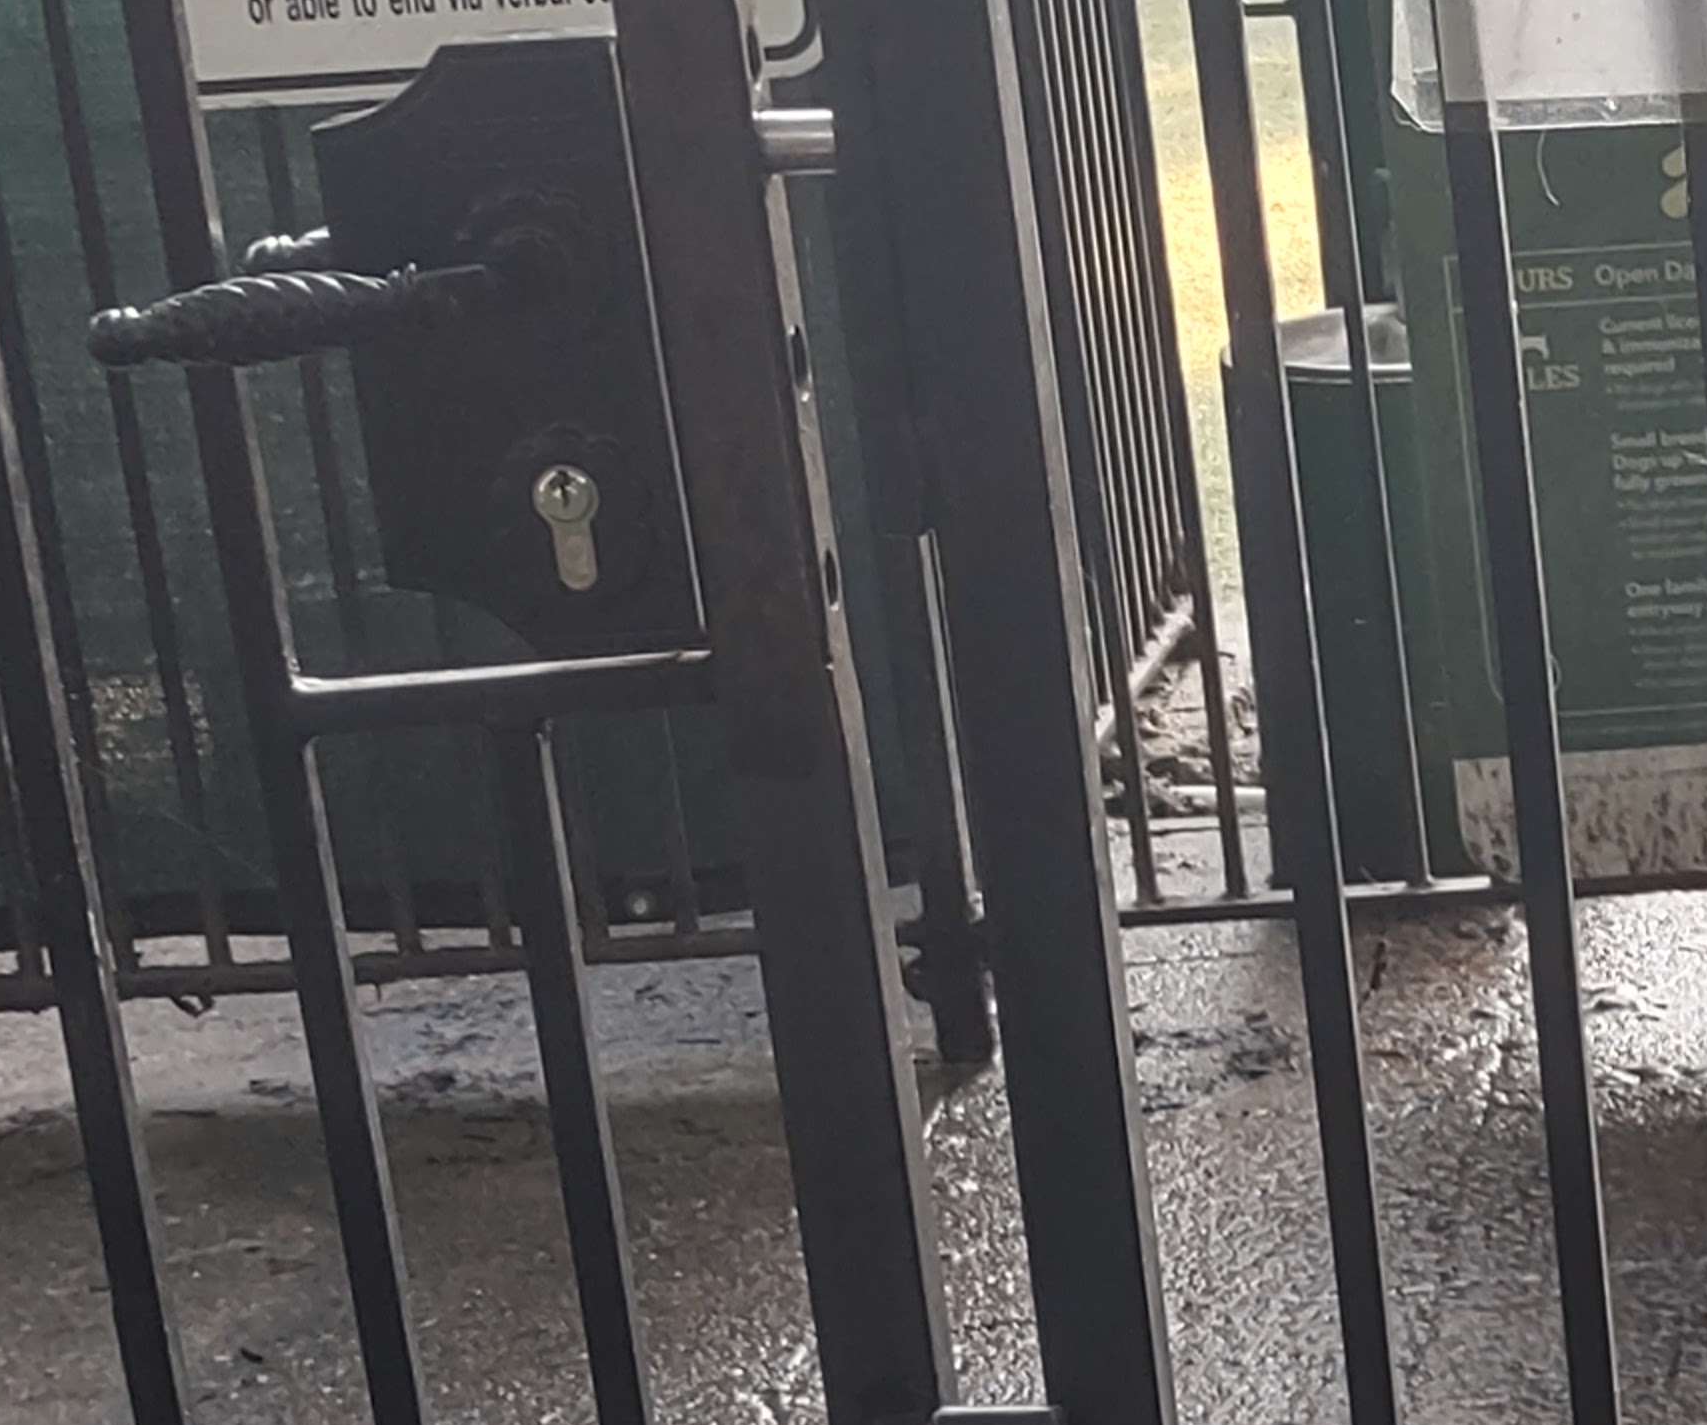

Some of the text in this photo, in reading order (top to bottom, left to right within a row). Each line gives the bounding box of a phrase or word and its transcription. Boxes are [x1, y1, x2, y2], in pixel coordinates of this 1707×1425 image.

[1516, 265, 1574, 293] URS
[1594, 261, 1661, 287] Open
[1524, 364, 1581, 392] LES
